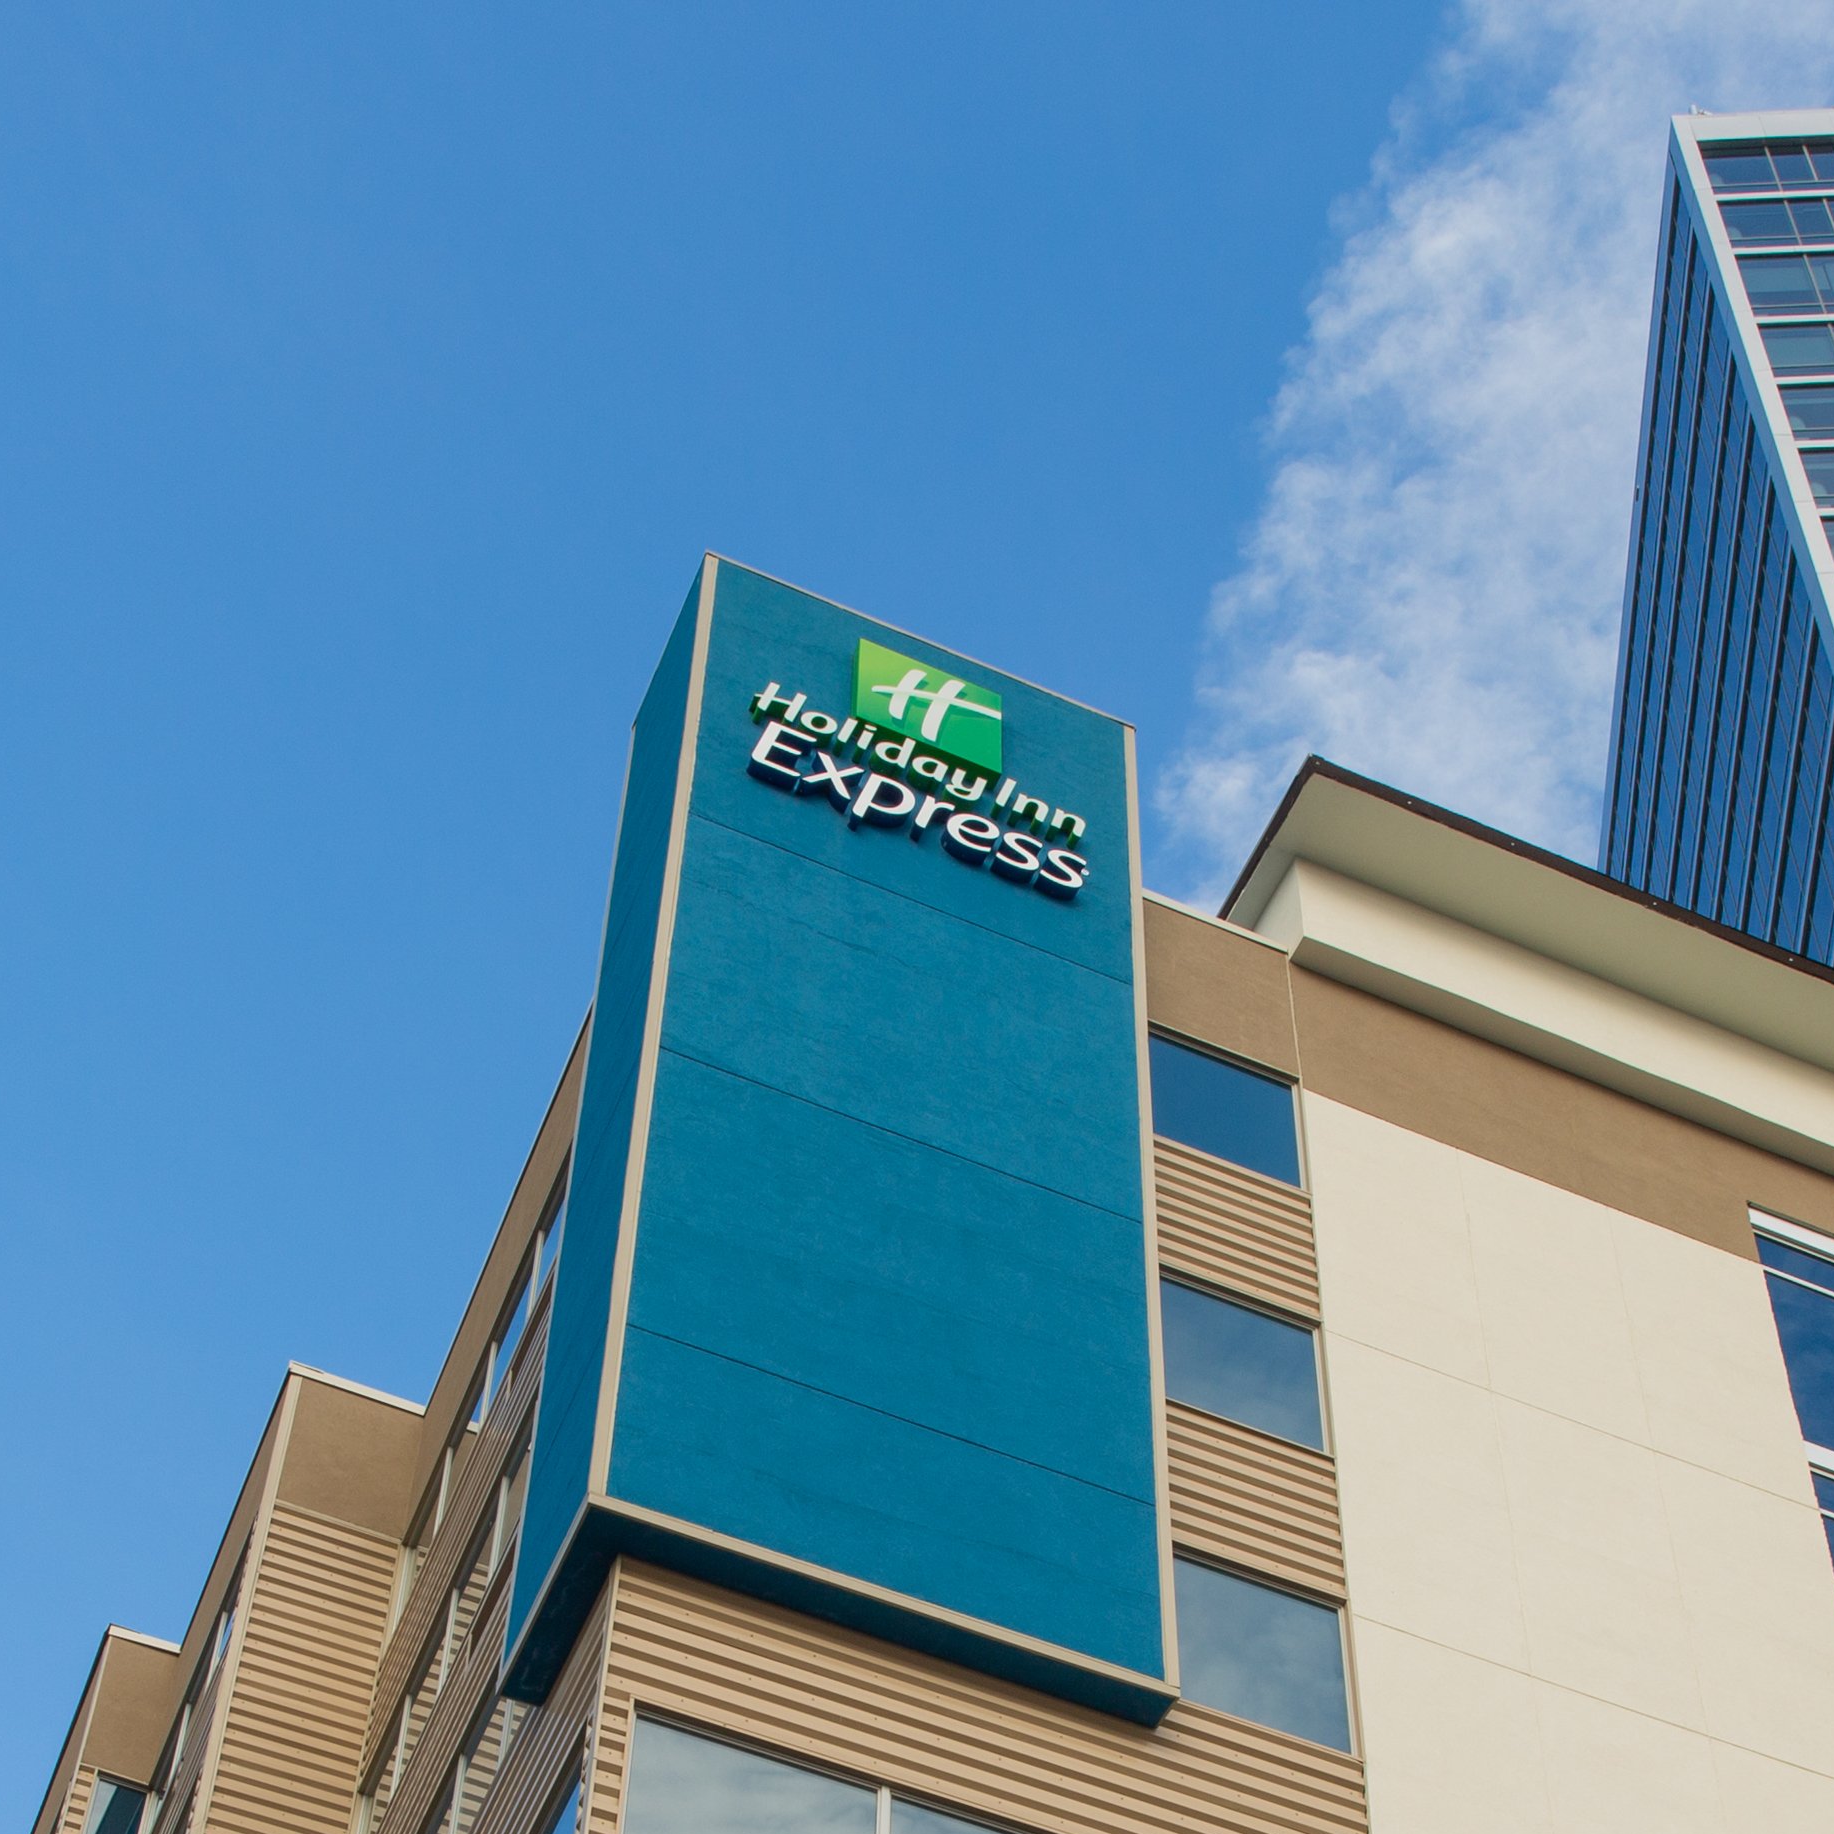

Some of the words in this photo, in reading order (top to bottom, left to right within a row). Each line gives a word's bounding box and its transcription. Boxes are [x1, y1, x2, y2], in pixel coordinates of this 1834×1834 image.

[750, 721, 1087, 889] Express
[754, 681, 988, 801] Holiday
[995, 777, 1087, 838] Inn
